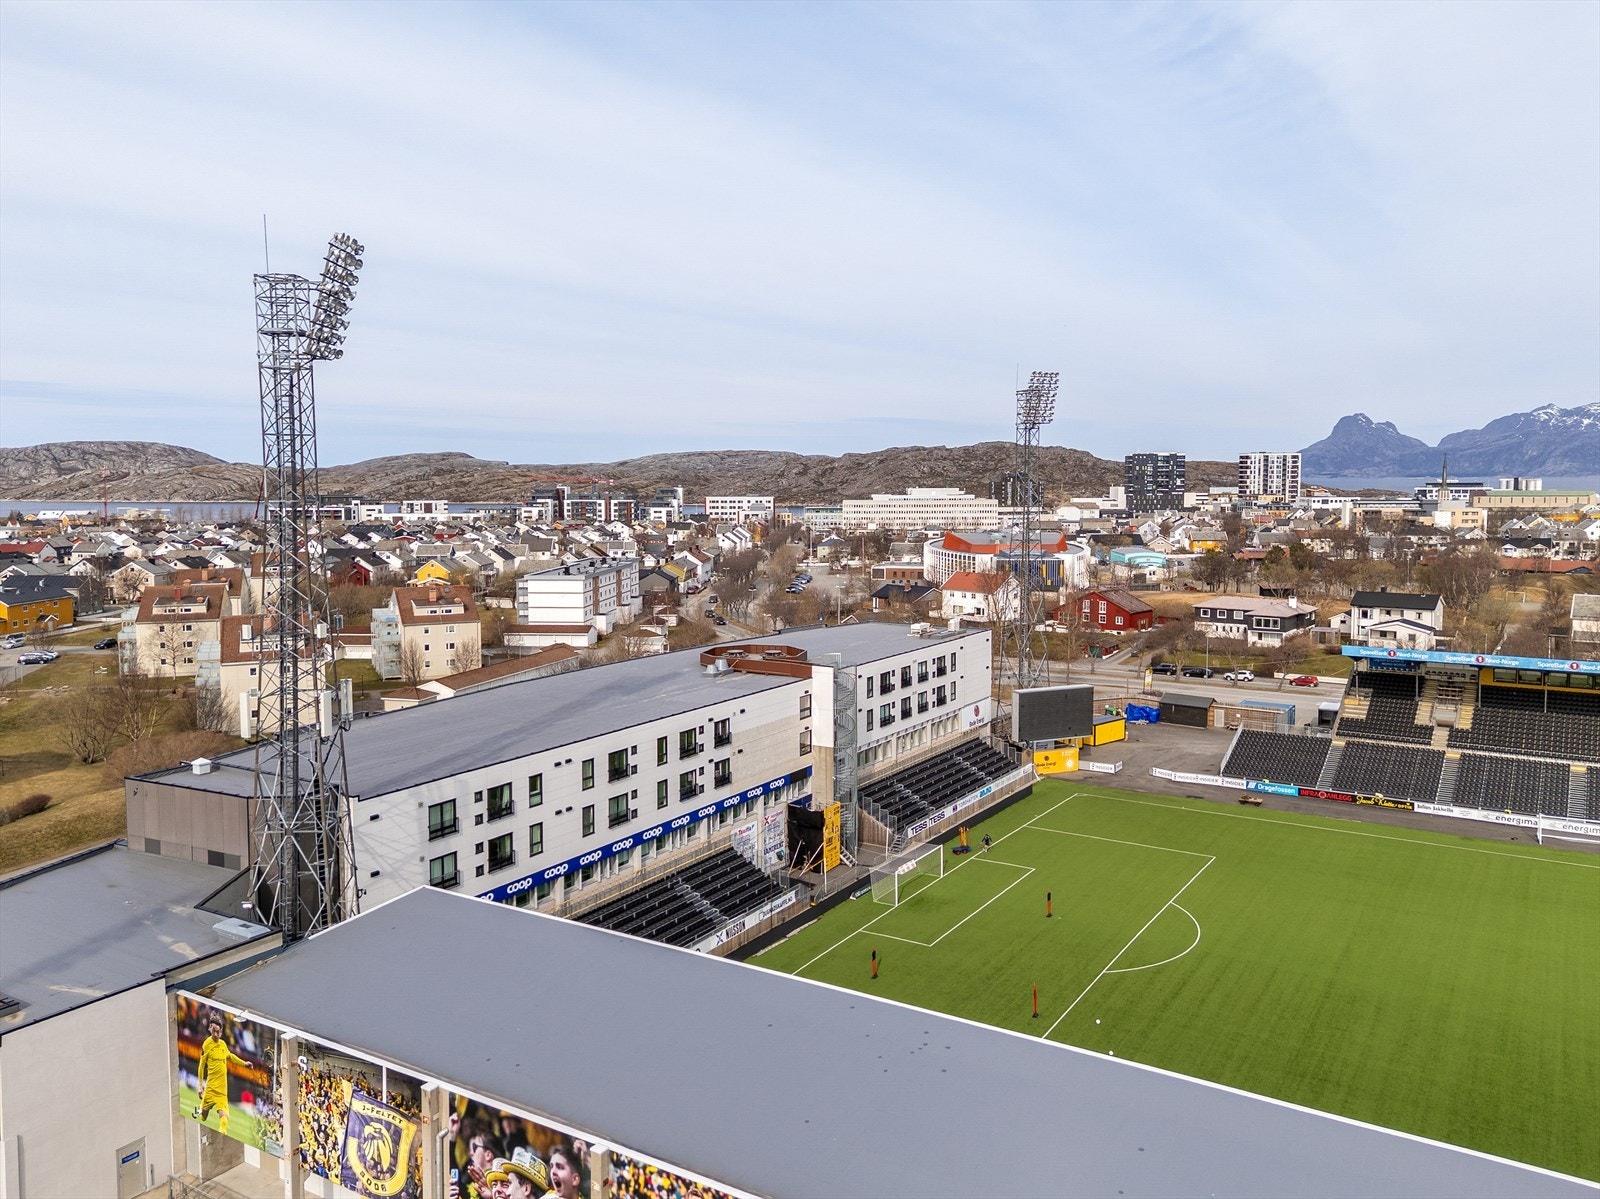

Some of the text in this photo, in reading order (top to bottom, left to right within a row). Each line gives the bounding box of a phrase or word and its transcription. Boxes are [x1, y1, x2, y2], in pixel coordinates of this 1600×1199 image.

[1396, 650, 1428, 659] Nord-Norge
[1446, 654, 1477, 662] SpareBank
[1485, 657, 1520, 666] Nord-Norge
[1537, 661, 1570, 670] SpareBank
[769, 778, 785, 789] coop
[1257, 783, 1296, 795] Dragefossen
[747, 786, 764, 798] coop
[1301, 789, 1353, 801] INFRA ANLEGG
[723, 795, 741, 807] coop
[698, 805, 717, 817] coop
[671, 815, 691, 828] coop
[929, 811, 946, 826] TESS
[1495, 814, 1538, 826] energima
[643, 826, 663, 840] coop
[910, 820, 928, 835] TESS
[612, 838, 634, 851] coop
[579, 850, 603, 865] coop
[544, 863, 569, 879] coop
[506, 877, 533, 894] coop
